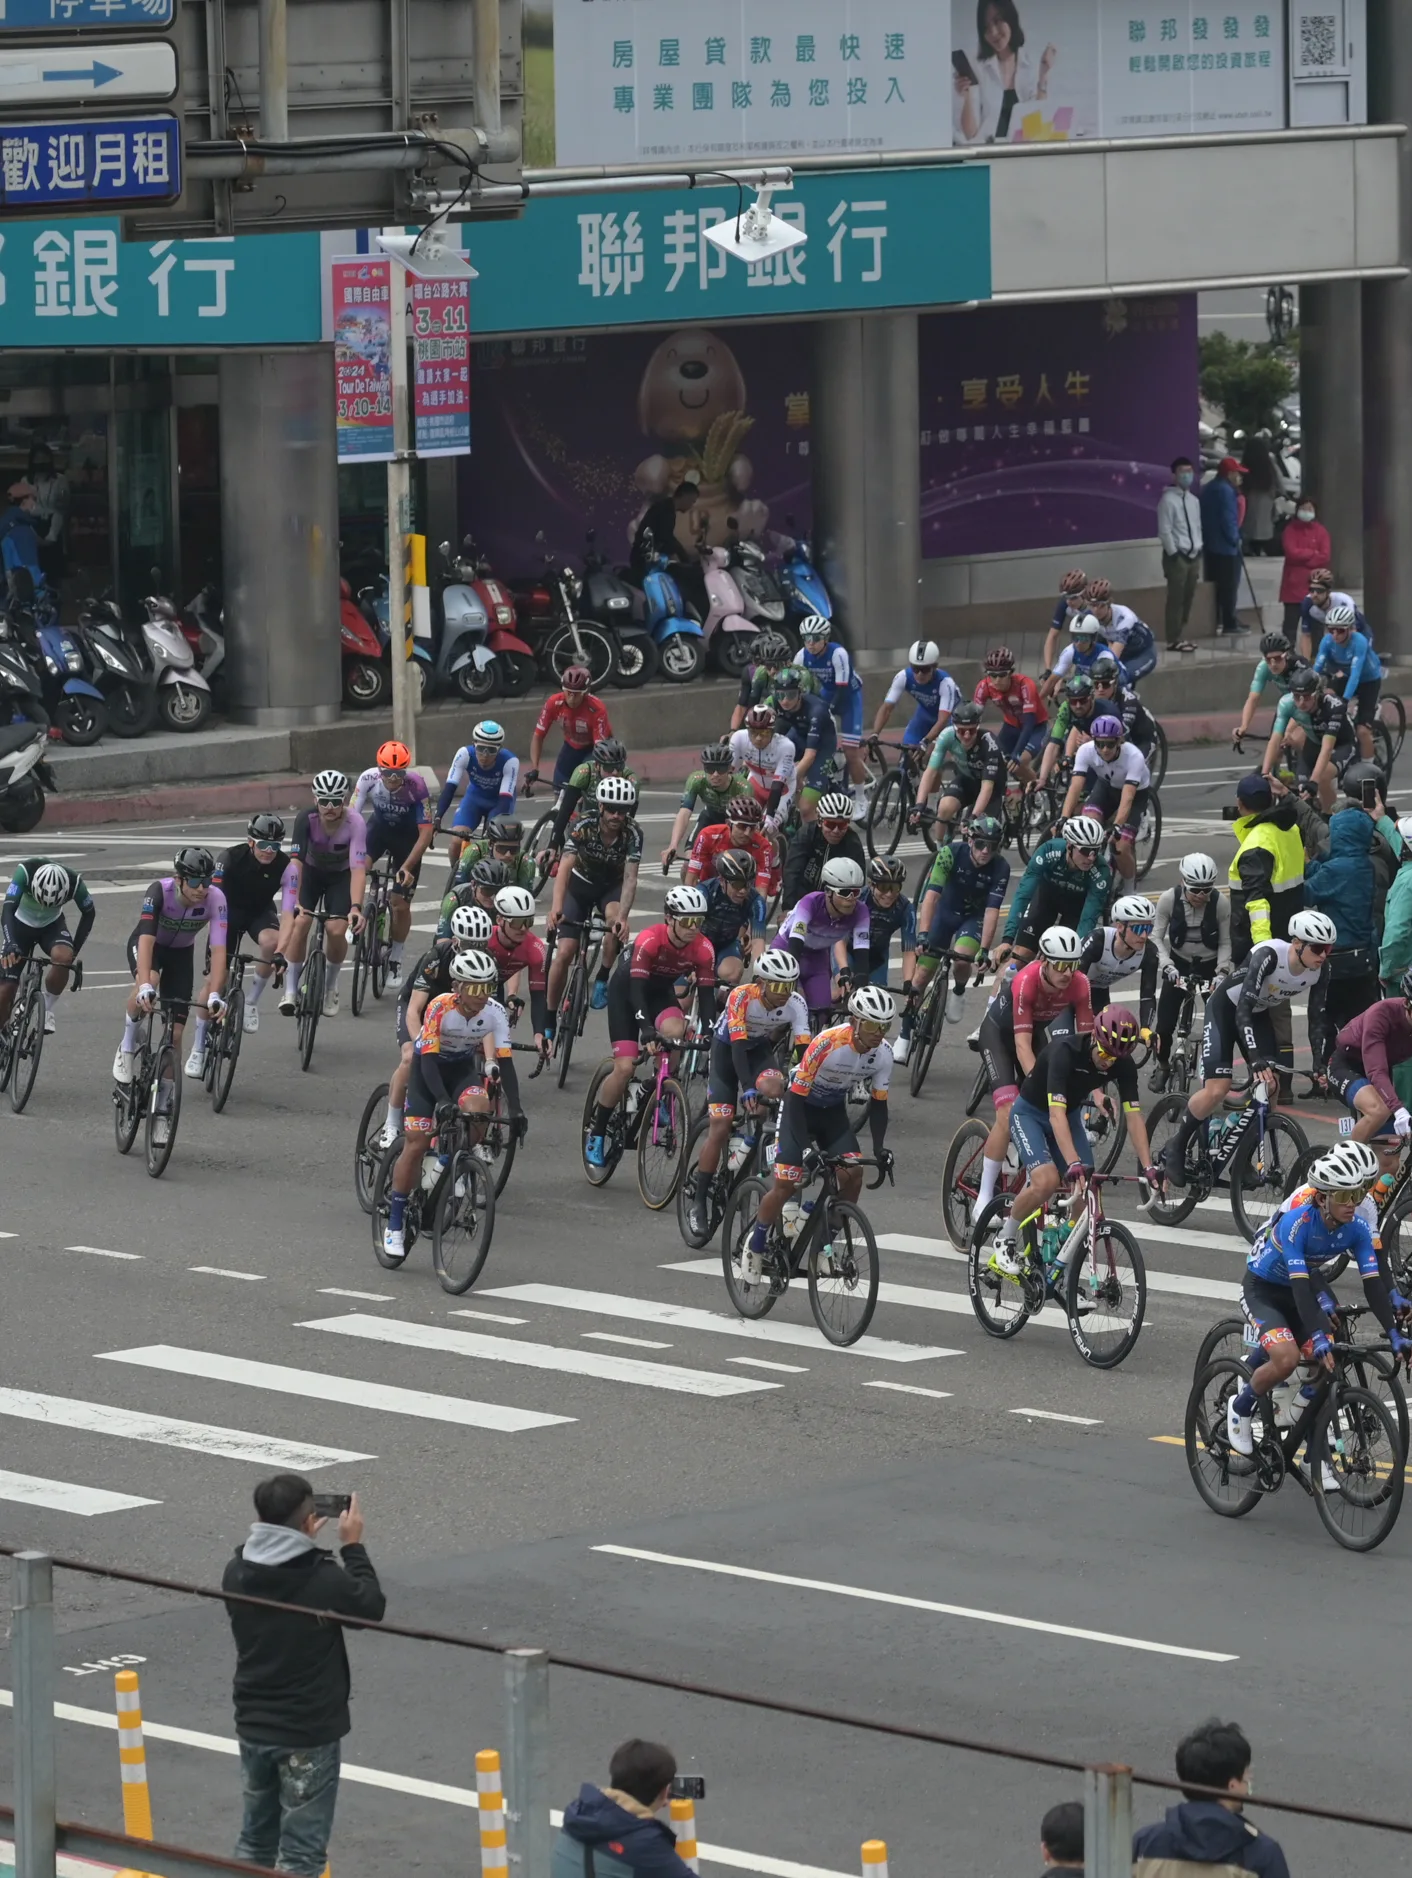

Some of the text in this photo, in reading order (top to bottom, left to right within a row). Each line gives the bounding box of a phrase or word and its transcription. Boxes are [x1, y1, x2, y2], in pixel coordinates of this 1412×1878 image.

[1129, 15, 1270, 42] 聯邦發發發
[612, 33, 905, 68] 房屋貸款最快速
[613, 77, 905, 113] 專業團隊為您投入
[3, 131, 169, 191] 歡迎月租
[338, 377, 390, 394] Tour De Taiwan
[961, 371, 1090, 409] 享受人生
[1217, 1107, 1255, 1161] CANYON
